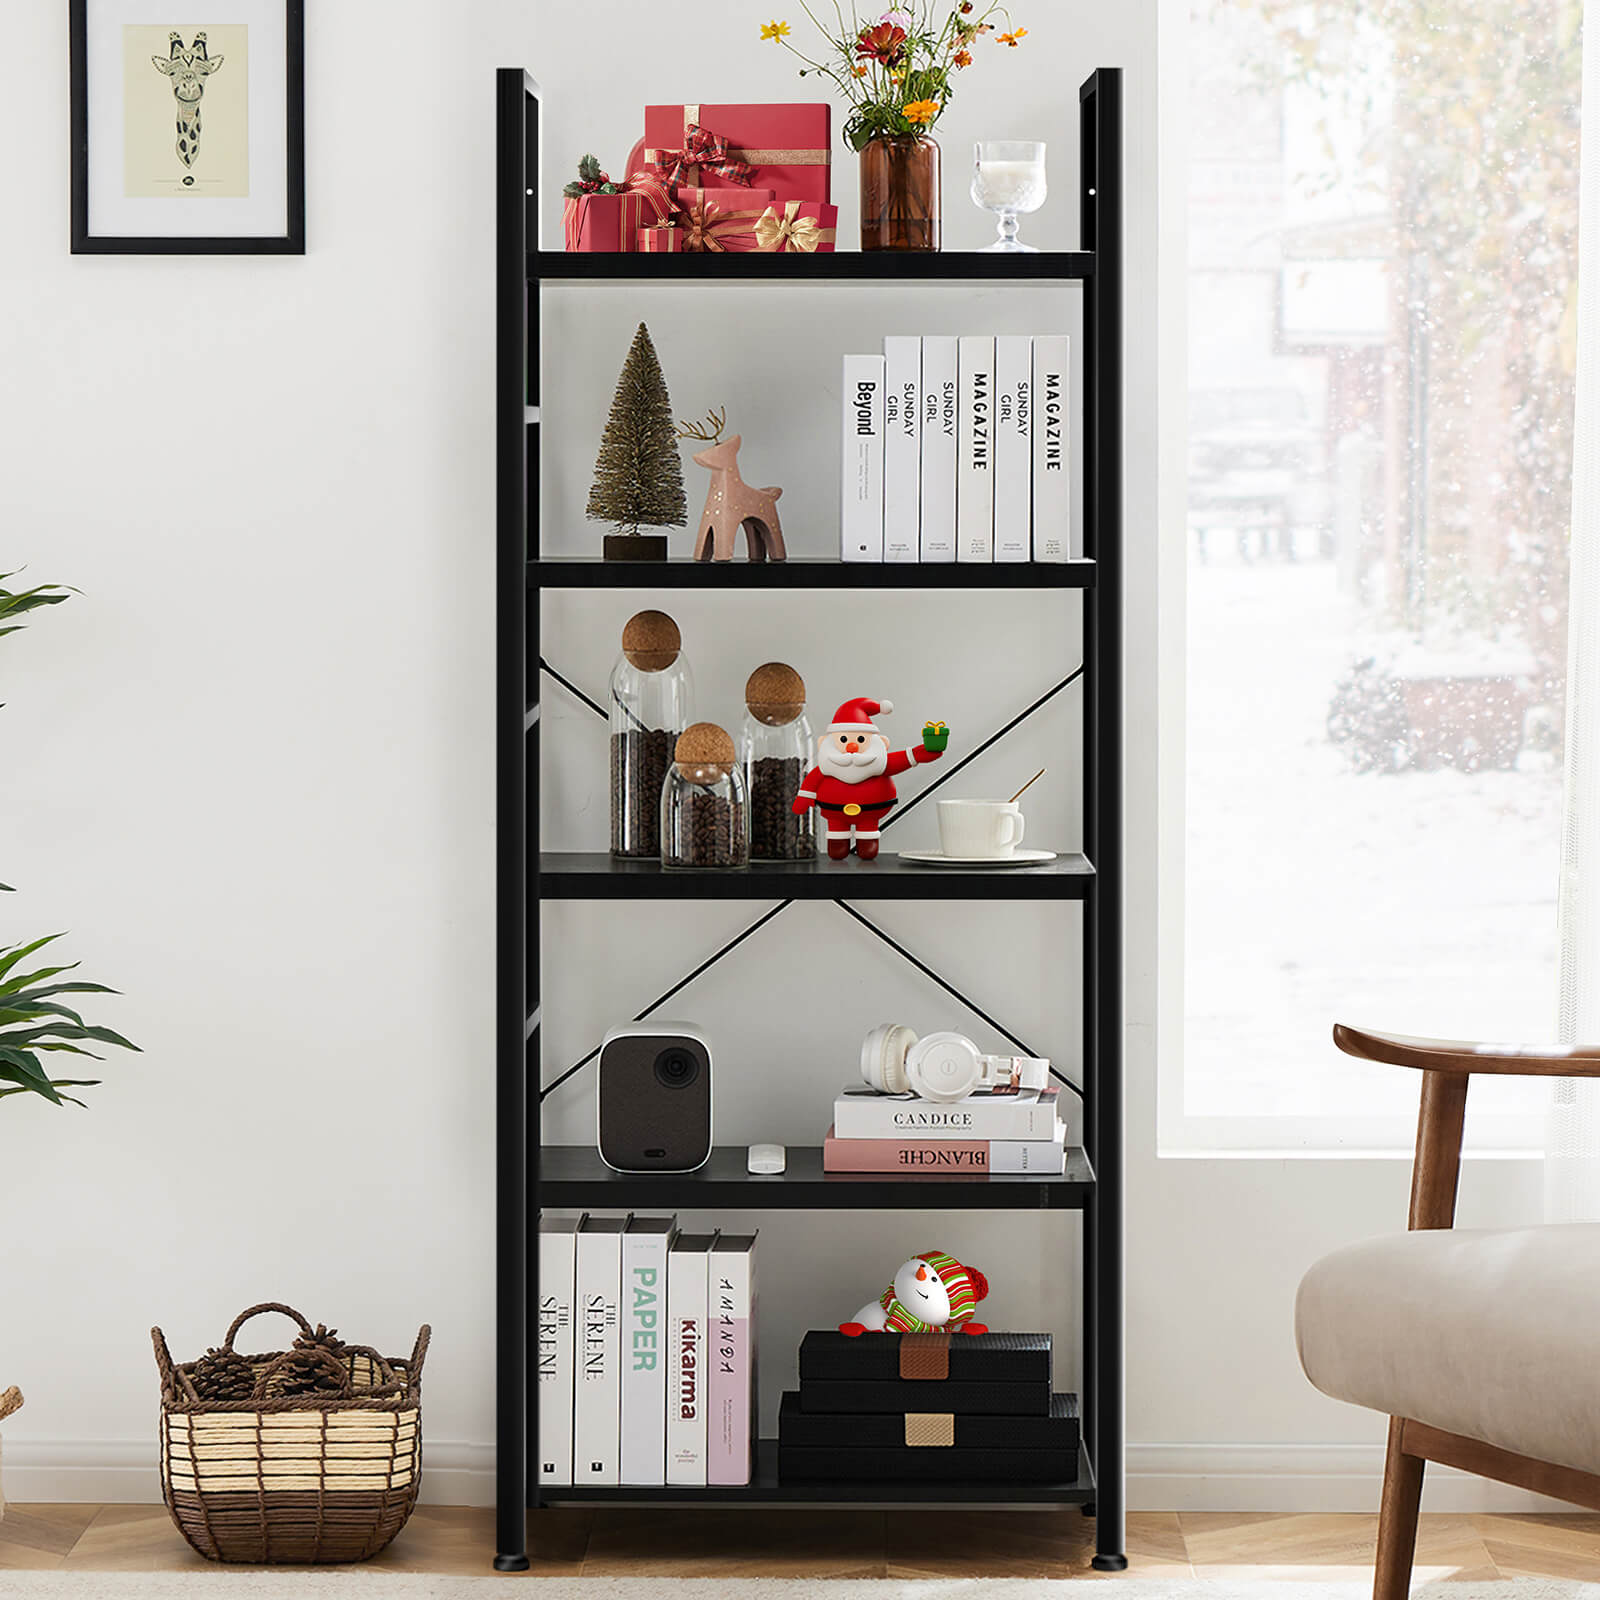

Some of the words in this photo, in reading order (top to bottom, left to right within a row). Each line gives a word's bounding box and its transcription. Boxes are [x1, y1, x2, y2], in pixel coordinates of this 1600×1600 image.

[853, 381, 876, 436] Beyond
[887, 395, 898, 425] GIRL
[903, 383, 915, 438] SUNDAY
[926, 394, 938, 424] GIRL
[942, 382, 954, 437] SUNDAY
[973, 373, 988, 471] MAGAZINE
[1000, 394, 1012, 424] GIRL
[1017, 382, 1029, 437] SUNDAY
[1046, 374, 1061, 471] MAGAZINE
[893, 1113, 973, 1126] CANDICE
[898, 1150, 986, 1166] BLANCHE
[539, 1295, 557, 1383] SERENE
[558, 1303, 569, 1330] THE
[585, 1293, 605, 1382] SERENE
[605, 1302, 616, 1328] THE
[633, 1267, 657, 1372] PAPER
[719, 1277, 735, 1377] AMANDA
